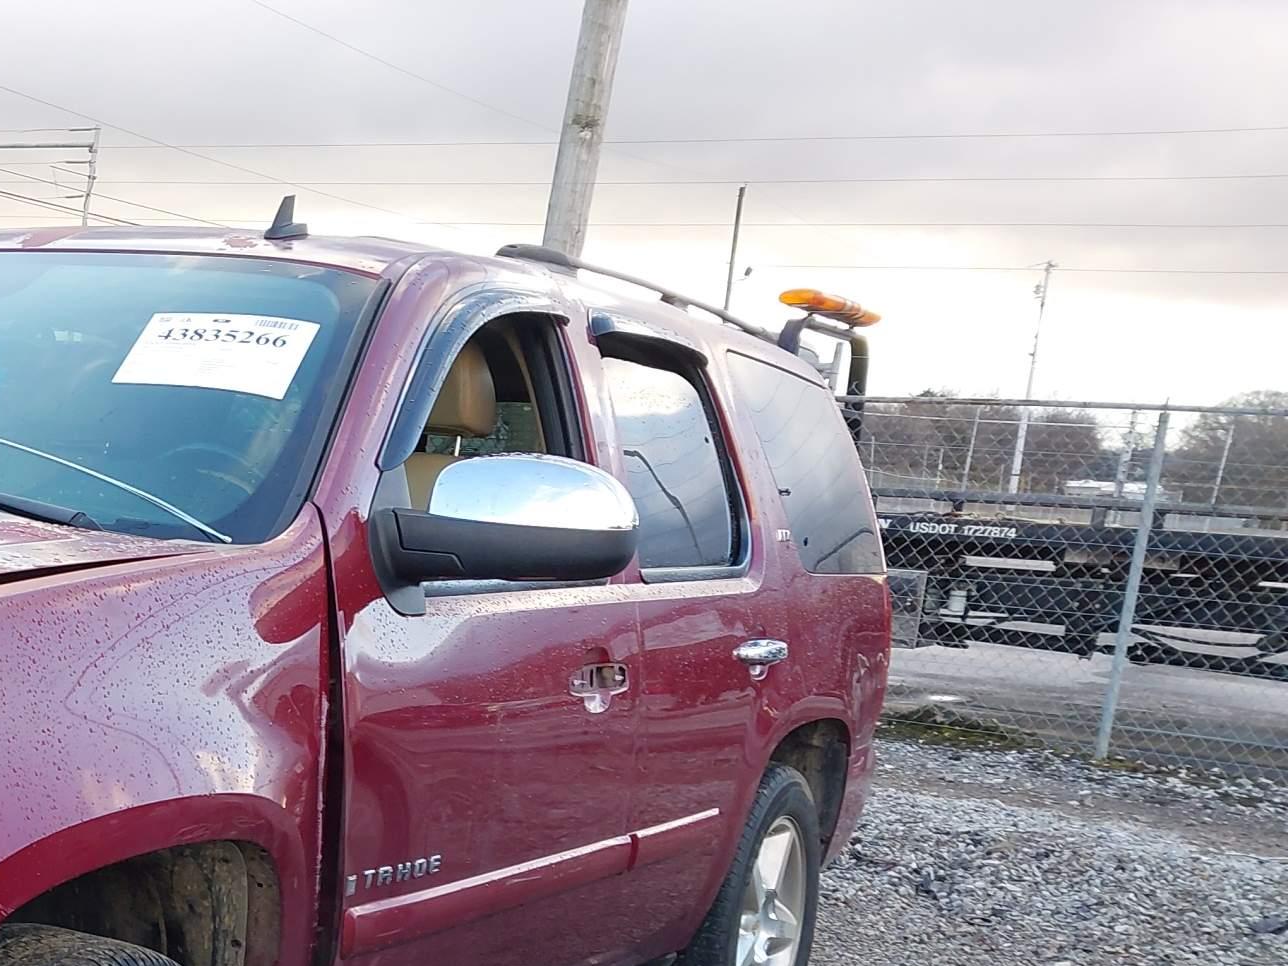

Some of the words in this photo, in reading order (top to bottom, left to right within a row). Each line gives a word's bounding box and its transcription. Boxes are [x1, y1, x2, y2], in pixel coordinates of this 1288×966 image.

[158, 328, 289, 348] 43835266
[910, 522, 959, 535] USDOT
[963, 526, 1017, 538] 1727874
[363, 855, 441, 888] TAHOE
